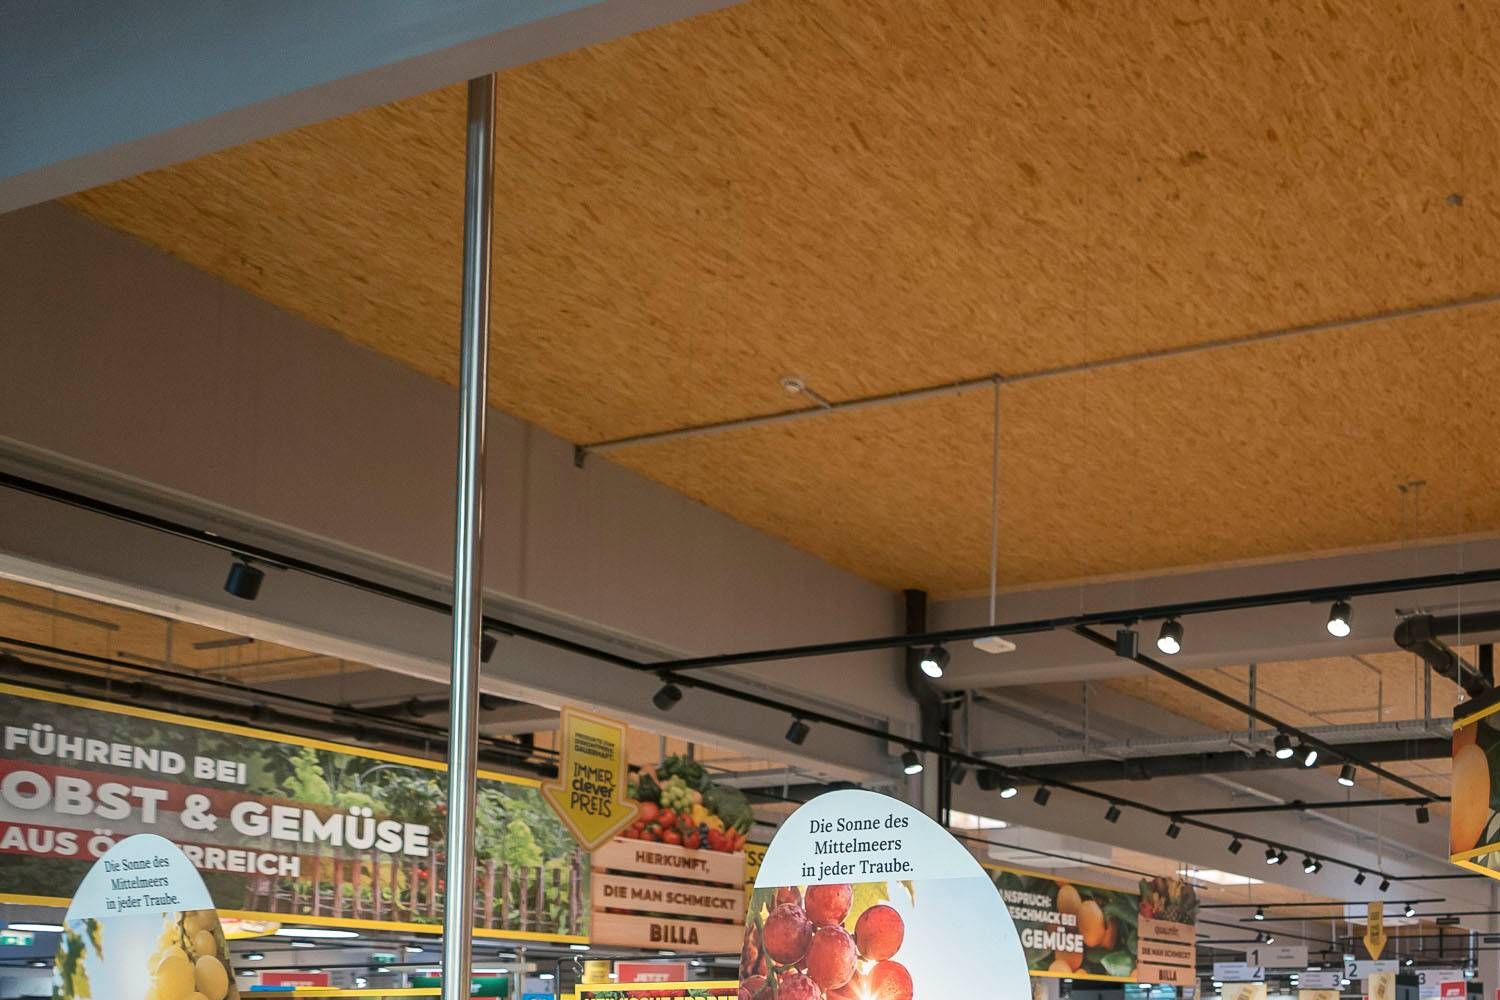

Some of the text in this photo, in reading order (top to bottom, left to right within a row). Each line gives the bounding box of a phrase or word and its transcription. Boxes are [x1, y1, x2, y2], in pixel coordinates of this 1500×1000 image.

[4, 723, 248, 785] FÜHREND BEI
[574, 762, 616, 787] IMMER
[572, 778, 614, 798] clever
[1, 771, 430, 857] OBST & GEMÜSE
[571, 791, 612, 818] PREIS
[809, 814, 909, 834] Die Sonne des
[2, 827, 300, 878] AUS ÖRREICH
[814, 836, 902, 855] Mittelmeers
[104, 856, 169, 873] Die Sonne des
[635, 850, 710, 874] HERKUNFT,
[802, 858, 914, 881] in jeder Traube.
[111, 875, 169, 890] Mittelmeers
[106, 893, 180, 912] in jeder Traube.
[603, 884, 736, 910] DIE MAN SCHMECKT
[1010, 906, 1060, 924] ESCHMACK
[649, 924, 699, 945] BILLA
[1021, 927, 1084, 953] GEMÜSE
[1349, 964, 1358, 977] 2
